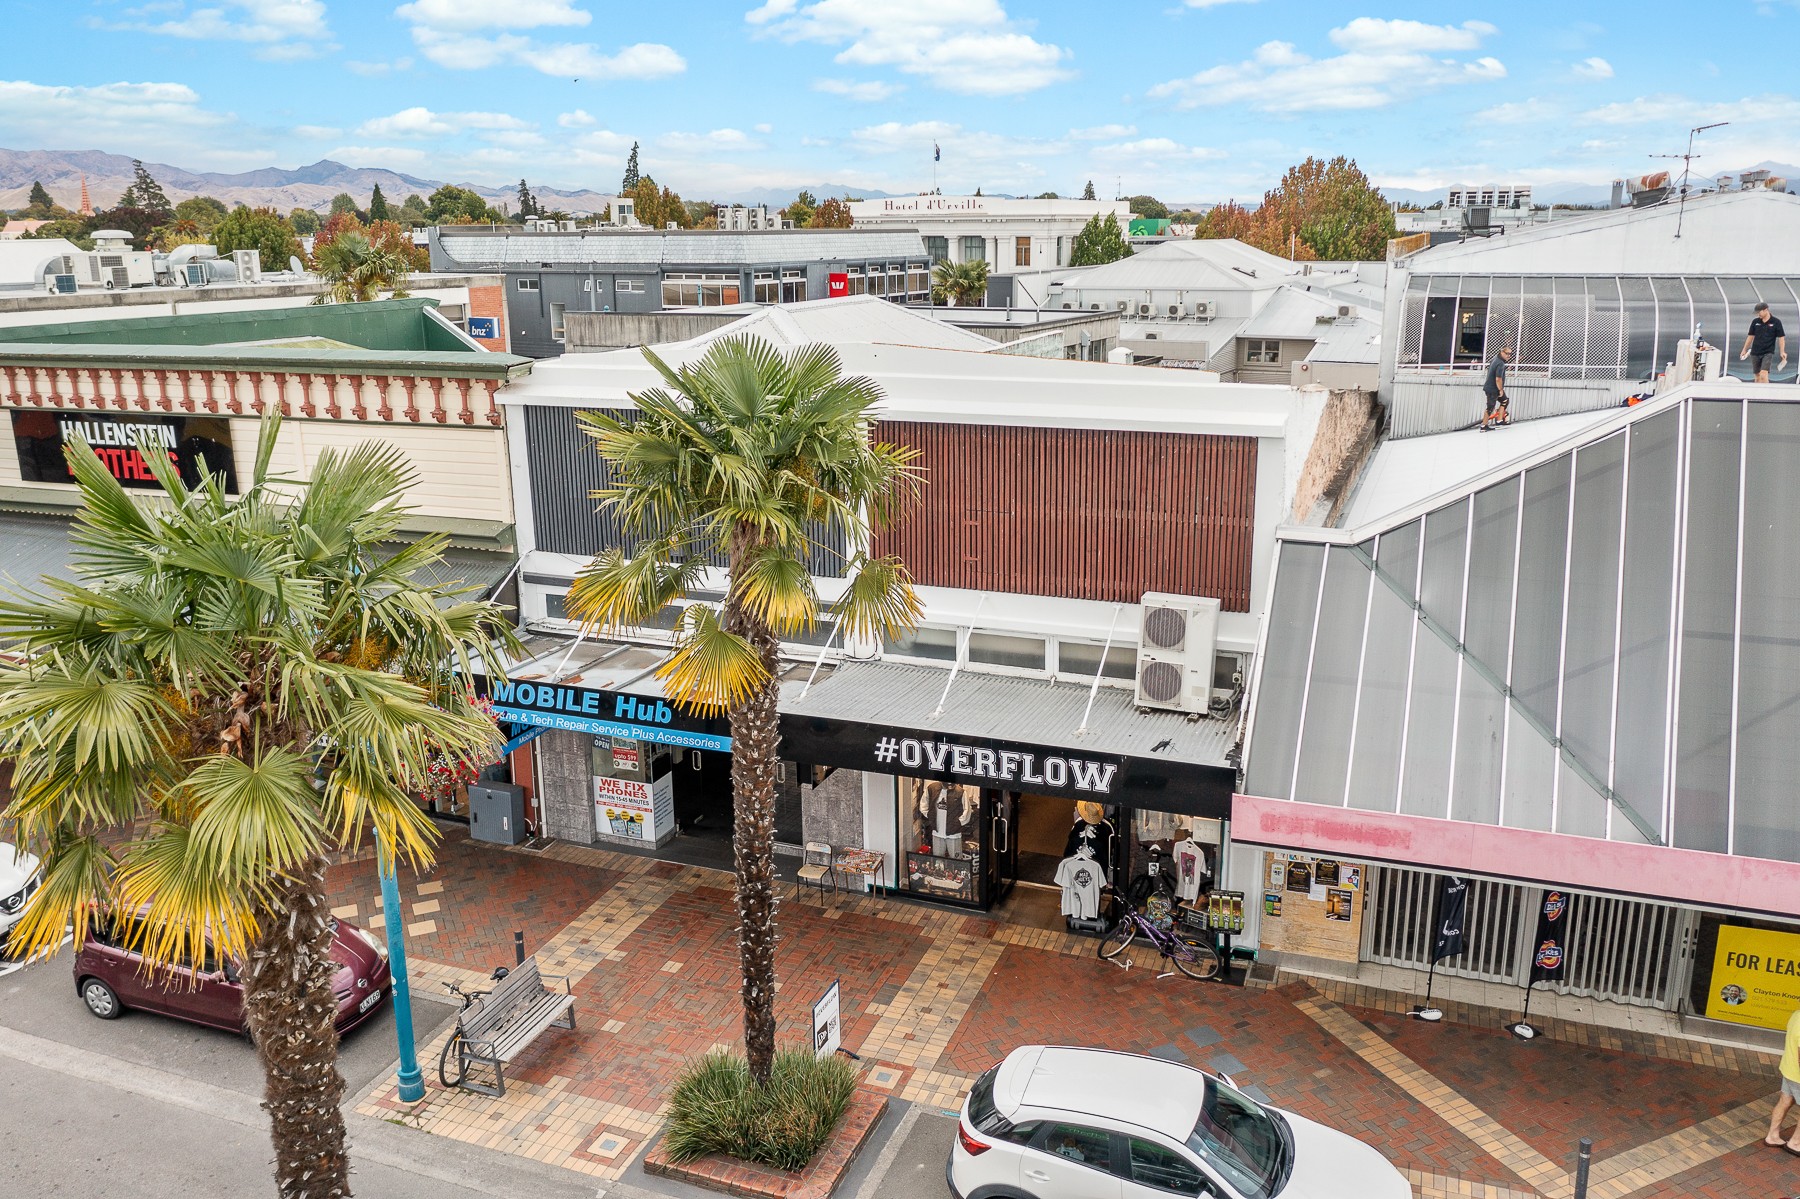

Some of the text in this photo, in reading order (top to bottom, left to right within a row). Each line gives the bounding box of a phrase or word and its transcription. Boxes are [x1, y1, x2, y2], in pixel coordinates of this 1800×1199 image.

[884, 199, 984, 210] Hotel d'Urville
[471, 325, 486, 336] bnz
[60, 420, 177, 448] HALLENSTEIN
[66, 446, 181, 481] OTHES
[493, 680, 672, 724] MOBILE Hub
[491, 707, 721, 749] hone & Tech Repair Service Plus Accessories
[594, 739, 610, 750] OPEN
[874, 736, 1118, 793] #OVERFLOW
[599, 785, 648, 800] PHONES
[600, 778, 645, 792] WE FIX
[599, 793, 615, 801] WITHIN
[629, 797, 650, 806] MINUTES
[1727, 952, 1760, 970] FOR
[1753, 987, 1780, 997] Clayton
